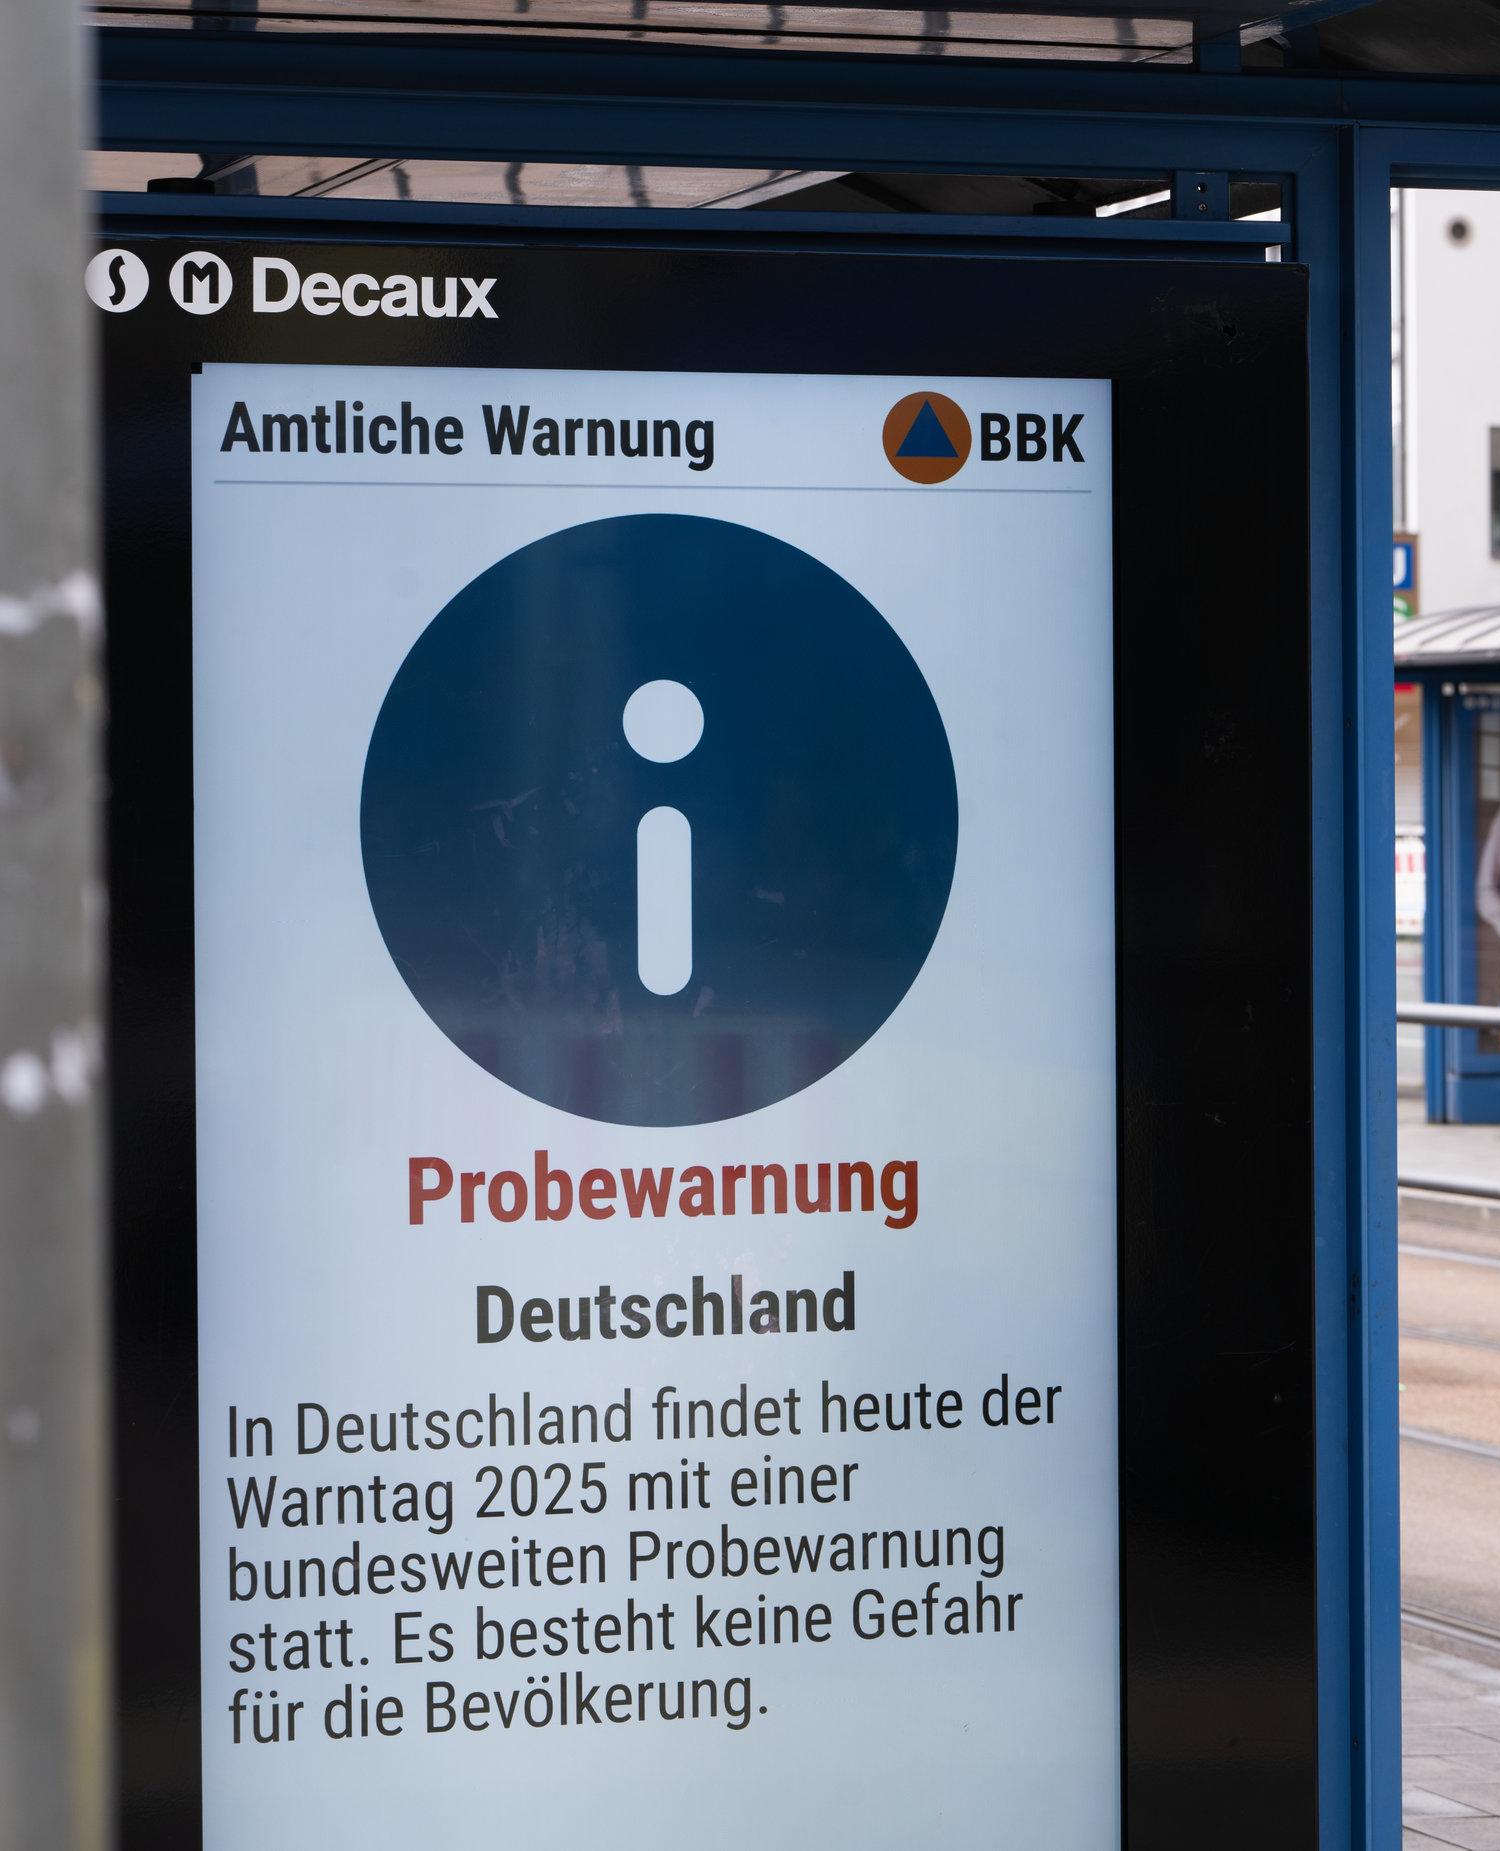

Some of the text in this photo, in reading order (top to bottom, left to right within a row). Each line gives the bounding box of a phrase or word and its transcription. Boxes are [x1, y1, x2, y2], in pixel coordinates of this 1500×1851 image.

[252, 256, 499, 319] Decaux
[219, 400, 714, 472] Amtliche Warnung
[980, 412, 1086, 463] BBK
[408, 1149, 919, 1230] Probewarnung
[476, 1270, 856, 1344] Deutschland
[229, 1372, 1063, 1458] In Deutschland findet heute der
[226, 1454, 859, 1535] Warntag 2025 mit einer
[229, 1523, 1004, 1602] bundesweiten Probewarnung
[229, 1580, 1024, 1674] statt. Es besteht keine Gefahr
[228, 1671, 768, 1744] für die Bevölkerung.
